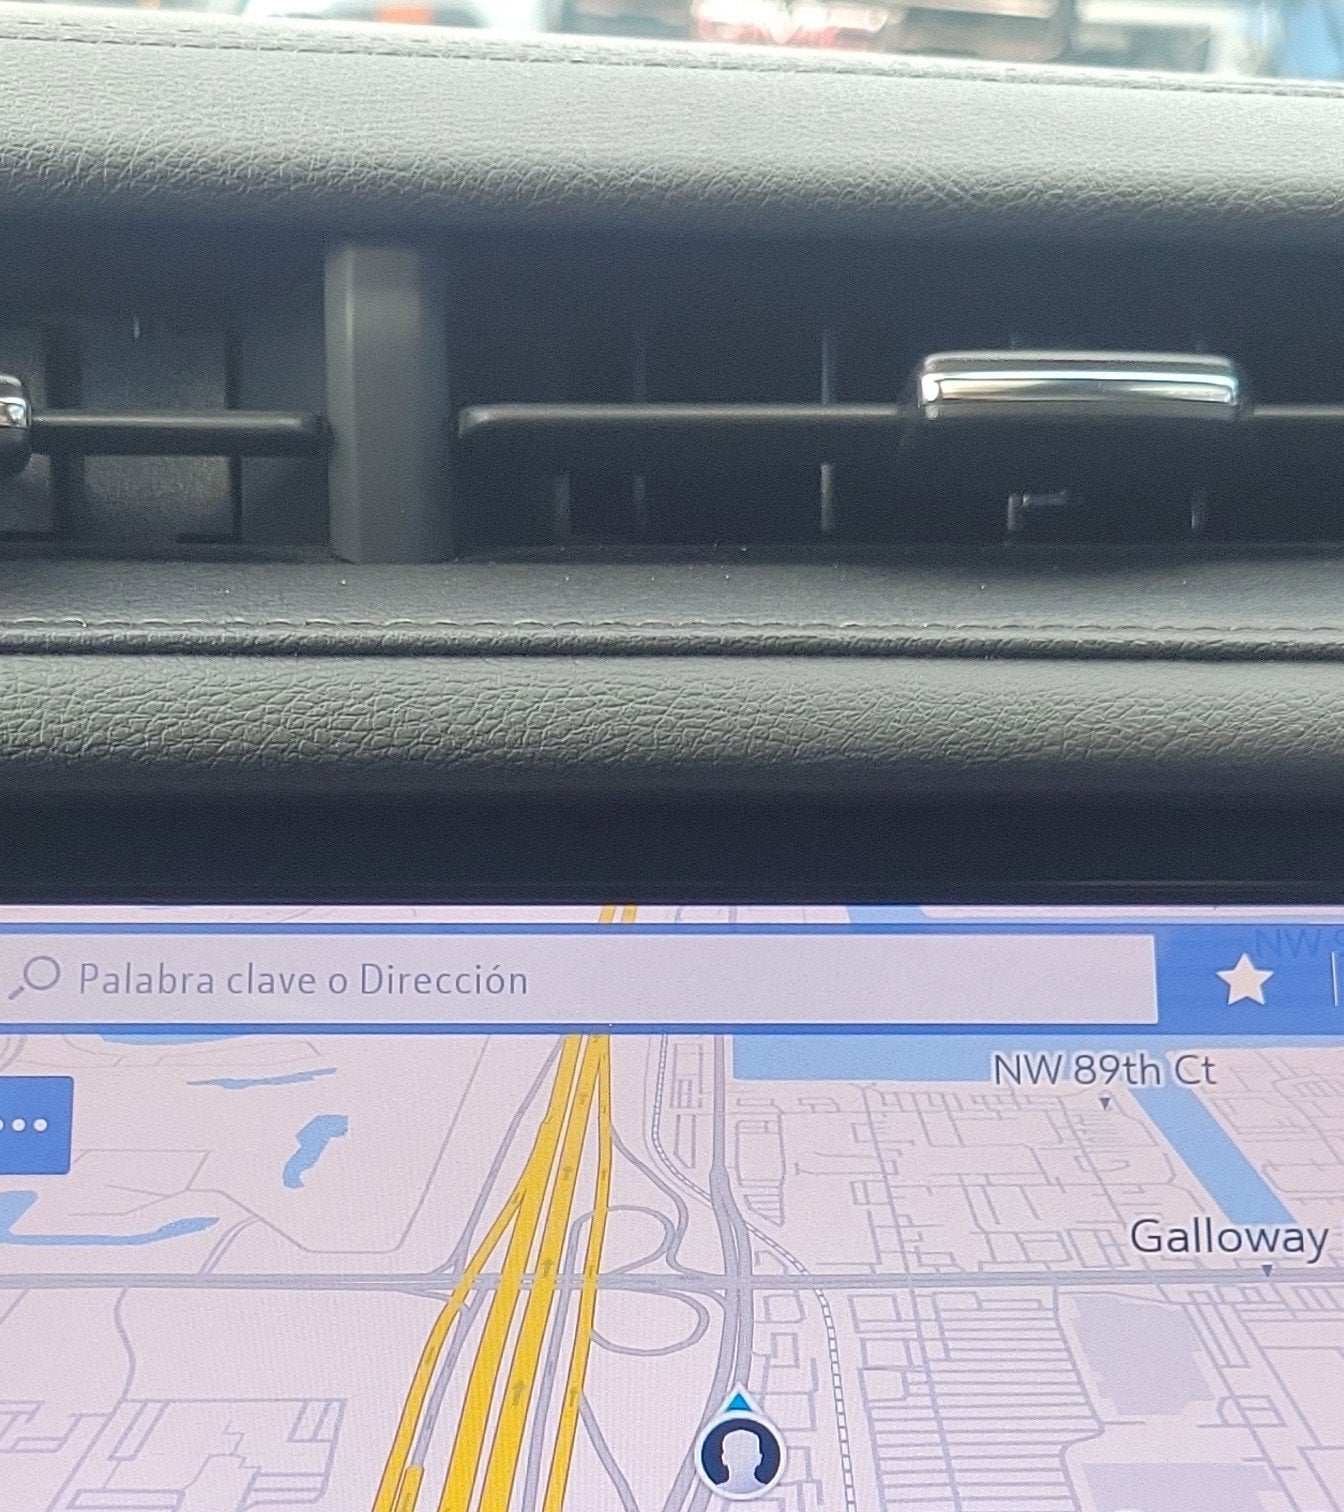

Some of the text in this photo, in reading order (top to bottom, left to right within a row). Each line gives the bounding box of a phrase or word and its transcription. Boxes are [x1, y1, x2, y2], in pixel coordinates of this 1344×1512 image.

[79, 961, 529, 995] Palabra clave o Dirección
[993, 1054, 1217, 1086] NW 89th Ct
[1130, 1216, 1329, 1264] Galloway
